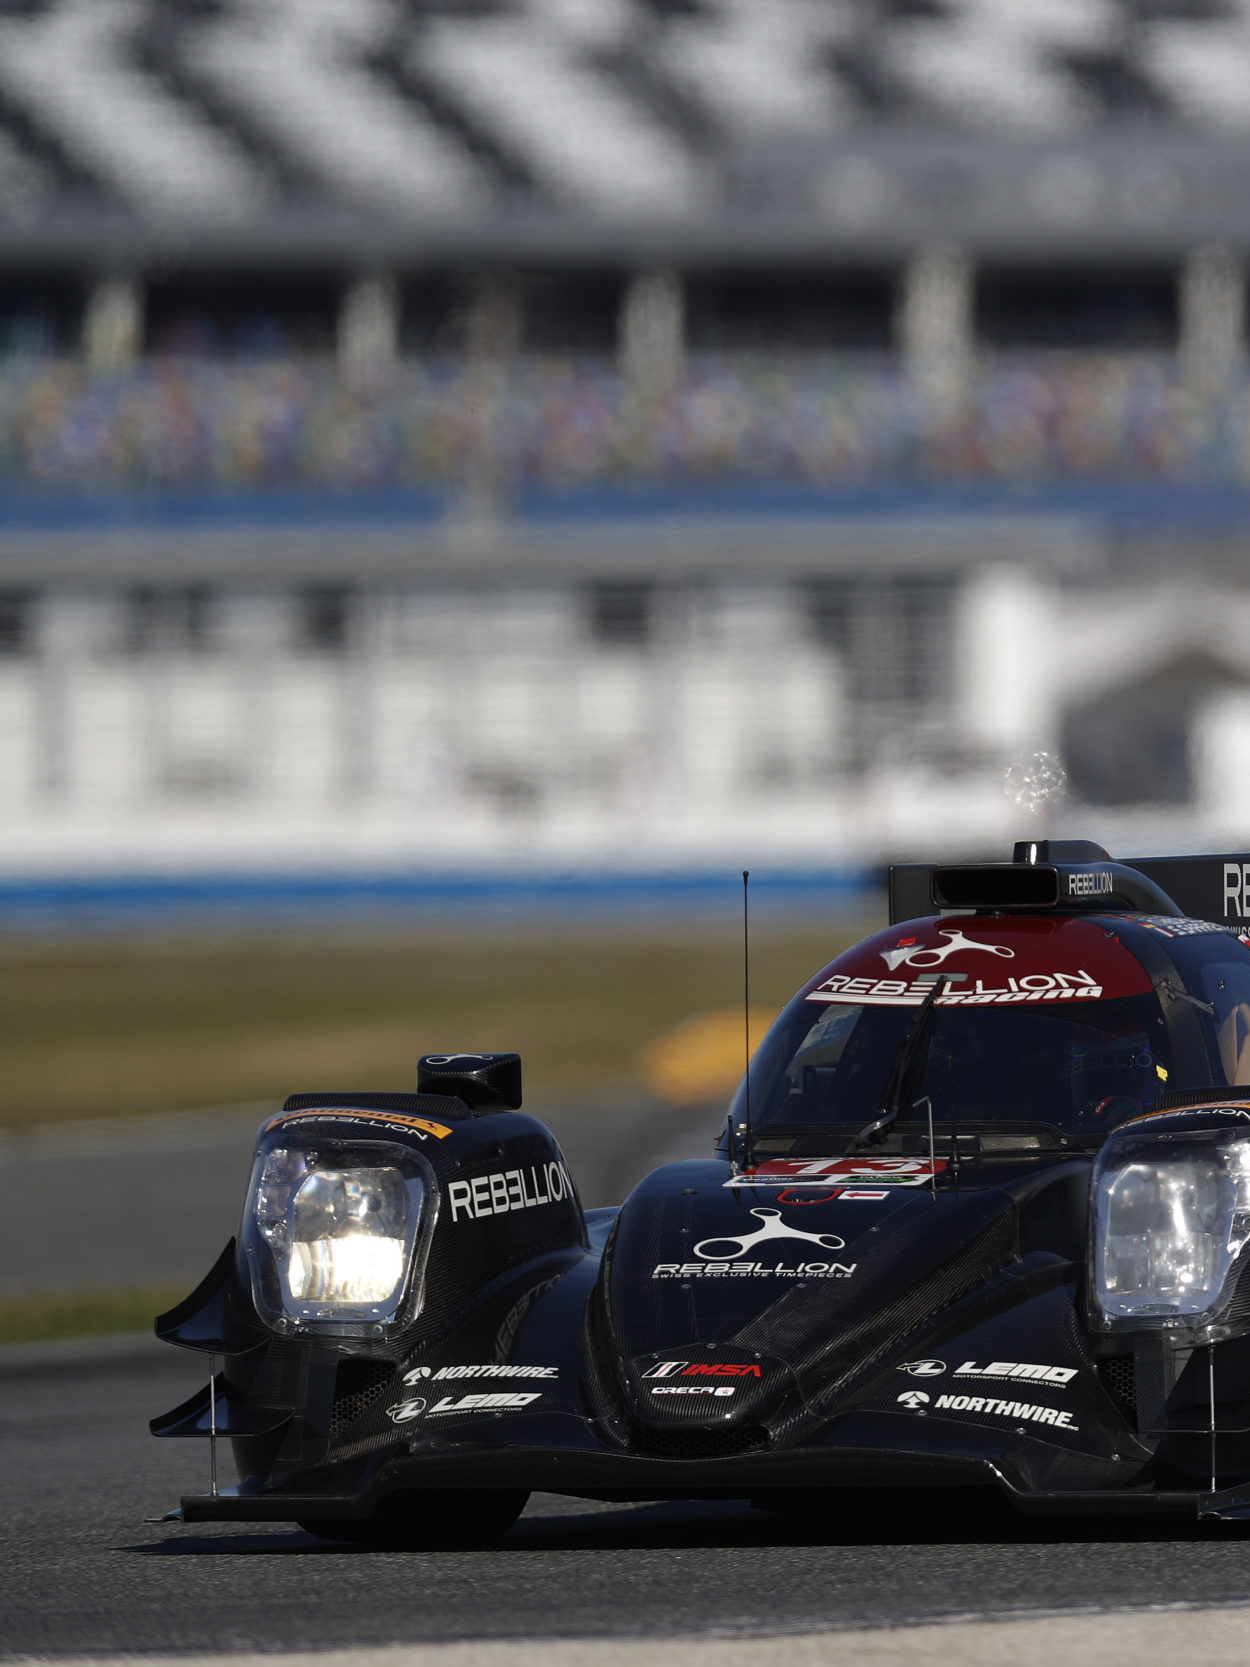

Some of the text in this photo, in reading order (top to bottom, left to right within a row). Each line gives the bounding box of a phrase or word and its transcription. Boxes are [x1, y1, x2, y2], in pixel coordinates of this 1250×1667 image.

[1069, 872, 1113, 896] REBELLION
[816, 969, 1098, 996] REBELLION
[282, 1115, 429, 1141] REBELLION
[788, 1158, 931, 1175] 13
[448, 1160, 575, 1223] REBELLION
[651, 1271, 691, 1279] SWISS
[653, 1262, 858, 1274] REBELLION
[431, 1365, 559, 1381] NORTHWIRE
[681, 1363, 762, 1378] IMSA
[954, 1361, 1079, 1384] LEMO
[651, 1386, 715, 1394] ORECA
[952, 1373, 1067, 1390] MOTORSPORT CONNECTORS
[428, 1393, 544, 1414] LEMO
[934, 1394, 1074, 1429] NORTHWIRE
